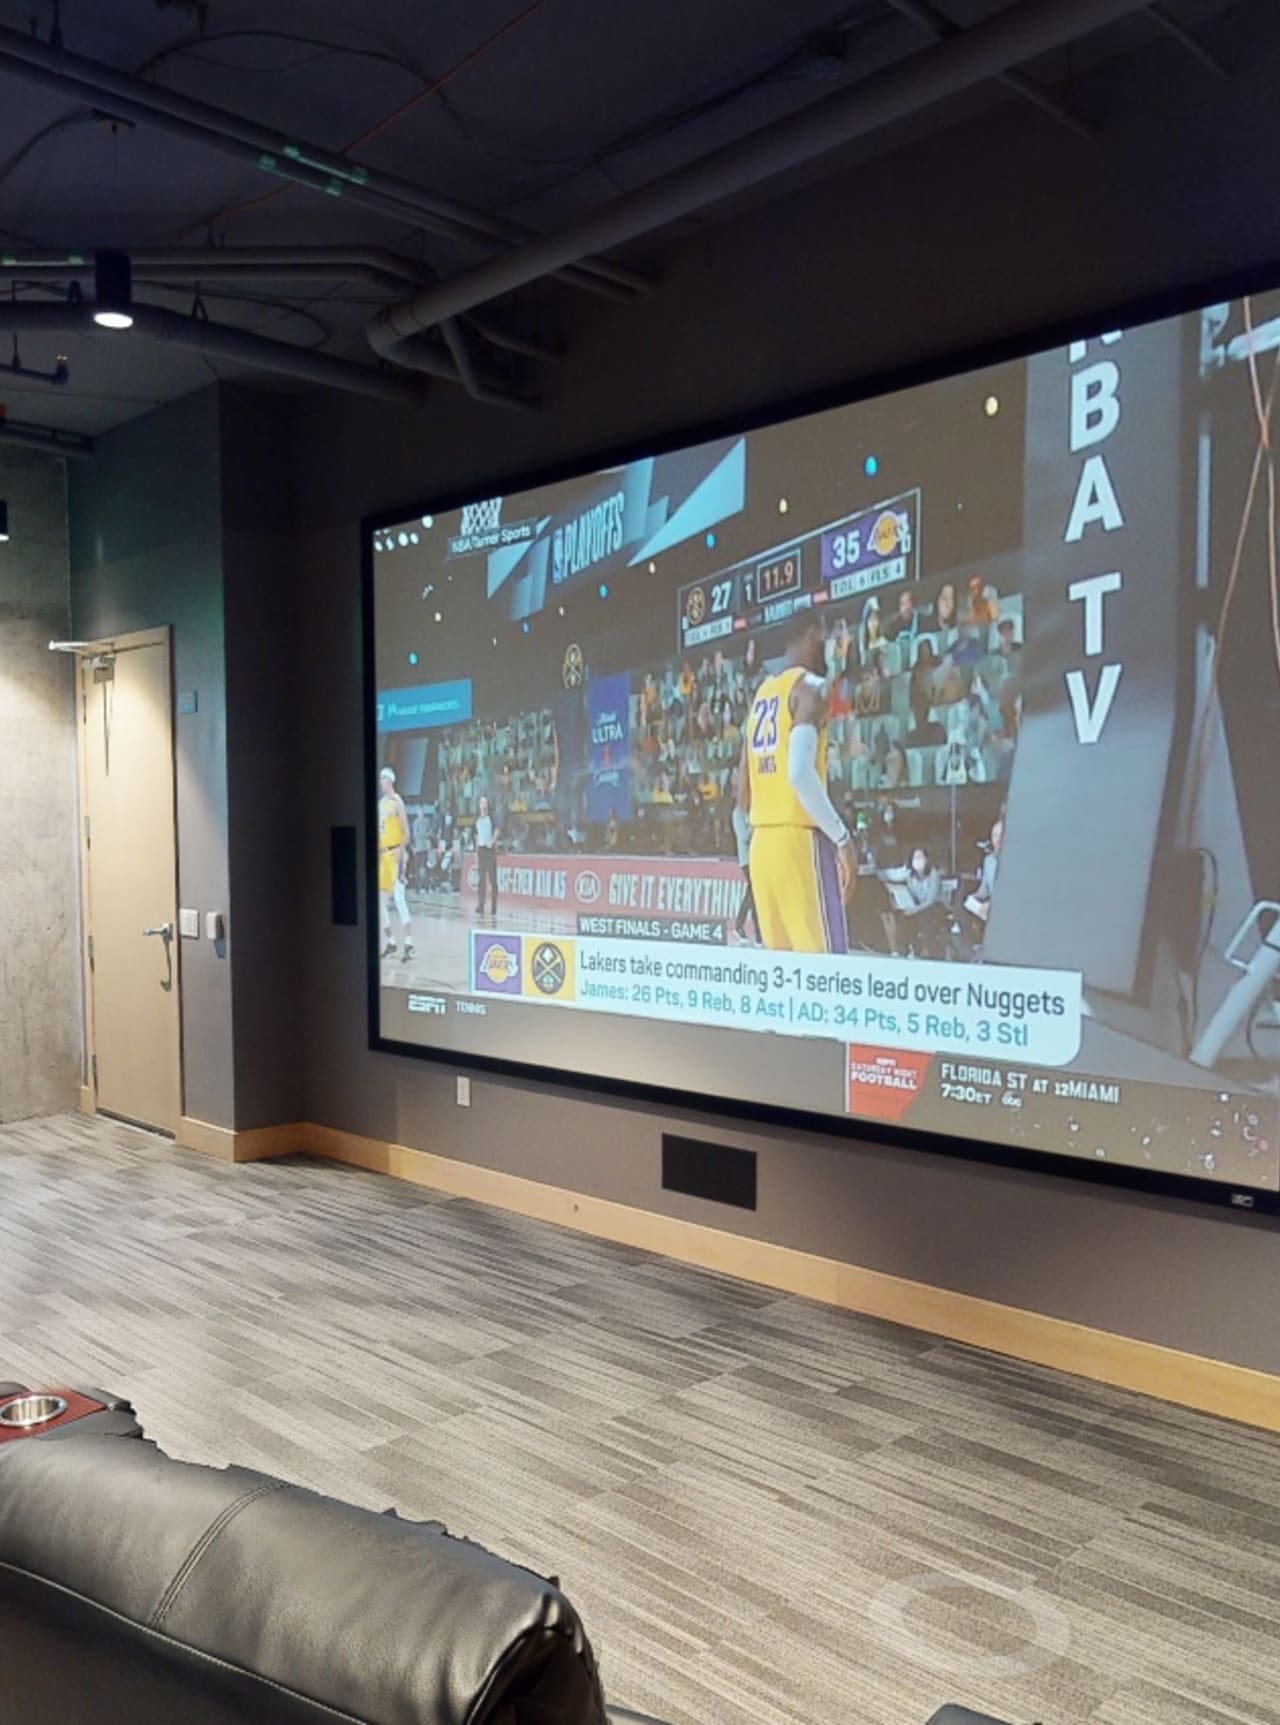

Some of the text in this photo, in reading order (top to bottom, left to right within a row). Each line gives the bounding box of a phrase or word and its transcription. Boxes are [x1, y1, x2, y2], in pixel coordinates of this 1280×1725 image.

[501, 525, 531, 545] Sports
[563, 491, 624, 579] PLAYOFFS
[832, 529, 860, 569] 35
[1064, 331, 1125, 745] BA TV
[763, 560, 794, 592] 11.9
[711, 581, 732, 613] 27
[592, 721, 623, 744] ULTRA
[753, 695, 779, 749] 23
[609, 873, 748, 918] GIVE IT EVERYTHIN
[580, 917, 614, 934] WEST
[615, 918, 661, 937] FINALS
[672, 921, 710, 939] GAME
[712, 924, 724, 940] 4
[580, 950, 1065, 1019] Lakers take commanding 3-1 series lead over Nuggets
[407, 994, 446, 1015] ESPN
[580, 980, 630, 1001] James:
[632, 983, 652, 1002] 26
[655, 986, 683, 1008] Pts,
[688, 990, 698, 1008] 9
[702, 991, 736, 1014] Reb,
[740, 995, 751, 1014] 8
[755, 998, 785, 1018] Ast
[797, 1001, 829, 1023] AD:
[833, 1004, 858, 1026] 34
[864, 1008, 901, 1034] Pts,
[907, 1013, 919, 1034] 5
[926, 1014, 970, 1043] Reb,
[976, 1020, 991, 1042] 3
[997, 1022, 1029, 1046] Stl
[851, 1071, 917, 1091] FOOTBALL
[941, 1063, 1002, 1087] FLORIDA
[1007, 1072, 1028, 1090] ST
[1032, 1079, 1048, 1094] AT
